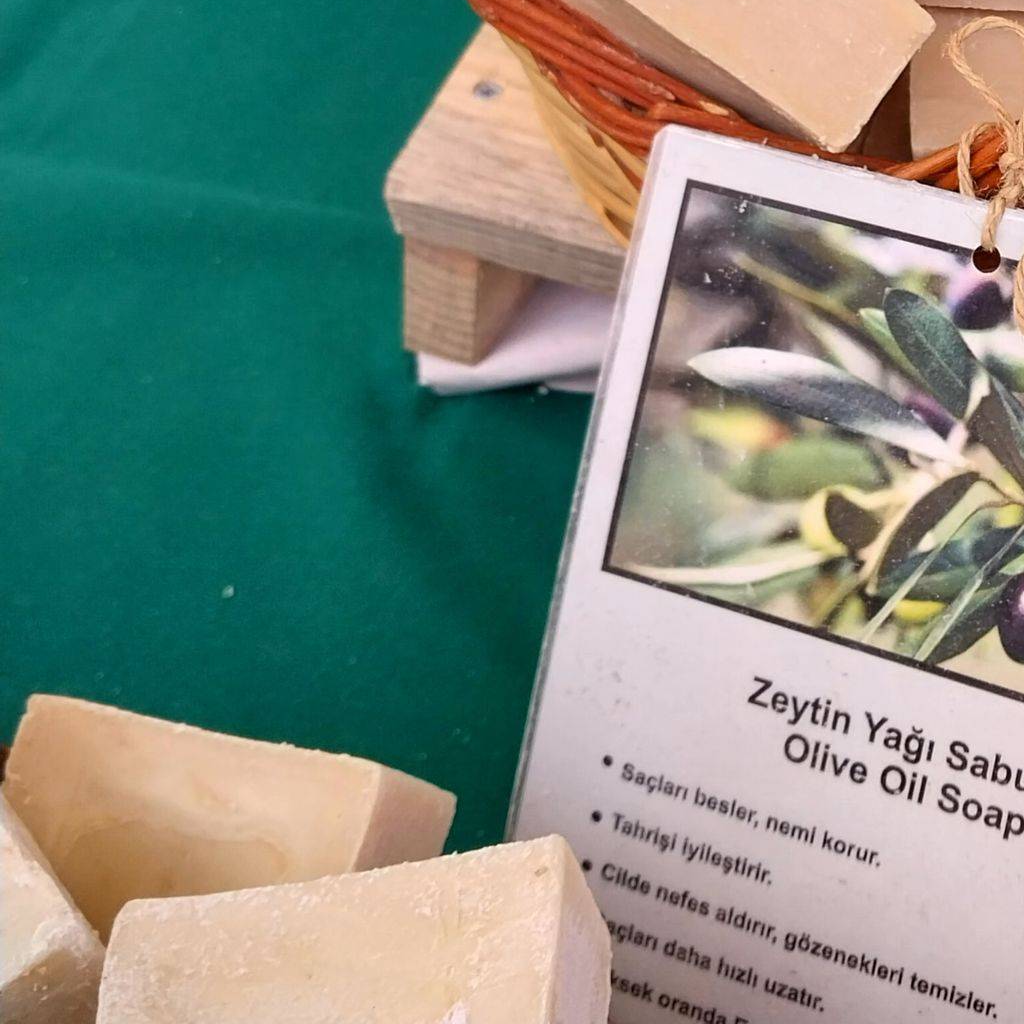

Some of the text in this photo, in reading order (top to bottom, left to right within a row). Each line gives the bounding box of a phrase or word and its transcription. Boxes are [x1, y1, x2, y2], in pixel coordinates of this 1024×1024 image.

[746, 676, 851, 734] Zeytin
[866, 712, 936, 765] Yağı
[620, 762, 881, 867] Saçları besler, nemi korur.
[783, 733, 868, 784] Olive
[880, 764, 926, 806] Oil
[611, 813, 774, 886] Tahrişi iyileştirir.
[601, 862, 998, 1019] Cilde nefes aldırır, gözenekleri temizler.
[601, 914, 826, 1013] açları daha hızlı uzatır.
